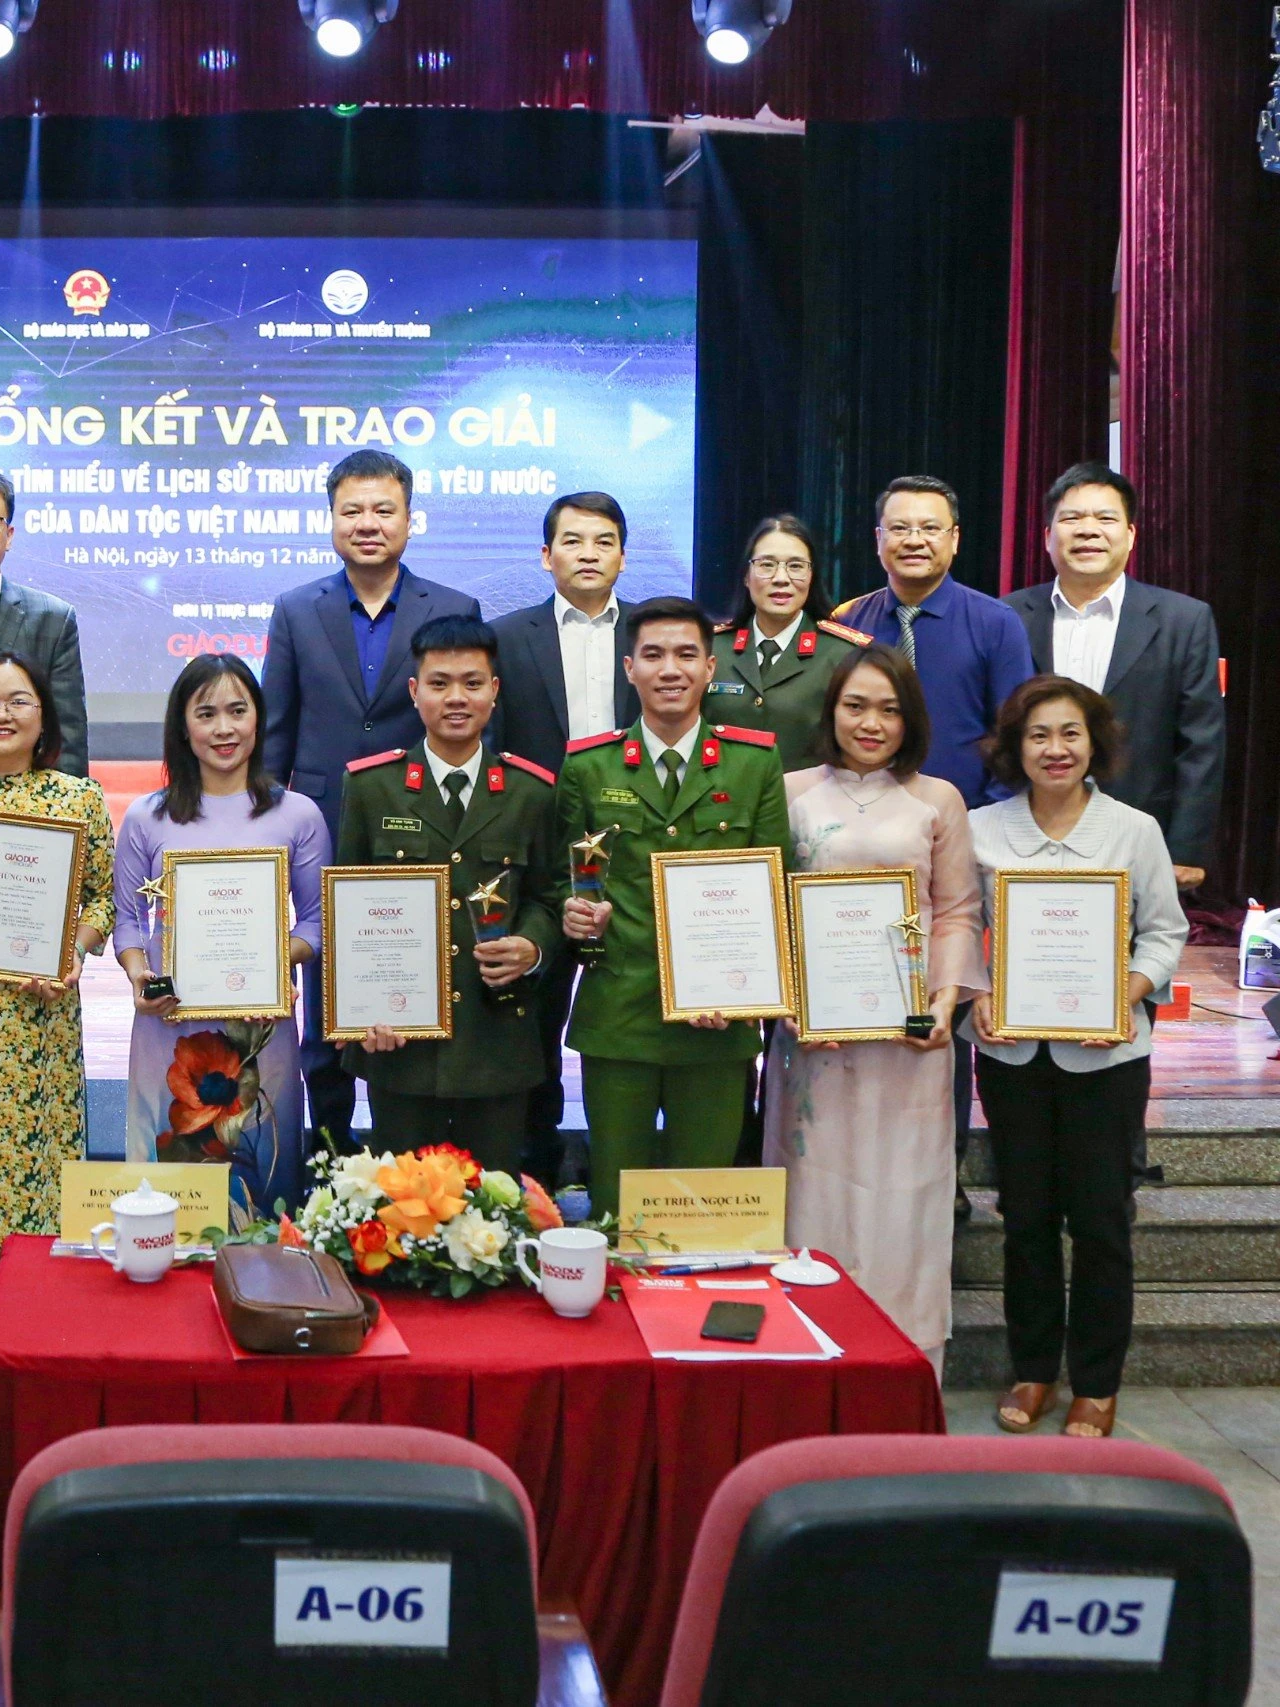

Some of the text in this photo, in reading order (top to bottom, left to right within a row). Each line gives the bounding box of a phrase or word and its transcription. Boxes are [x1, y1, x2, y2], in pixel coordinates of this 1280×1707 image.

[121, 388, 203, 446] KẾT
[217, 394, 289, 447] VÀ
[299, 406, 436, 447] TRAO
[448, 392, 556, 447] GIẢI
[10, 464, 54, 493] TÌM
[60, 459, 115, 493] HIỂU
[121, 461, 151, 493] VỀ
[157, 468, 210, 498] LỊCH
[216, 460, 253, 493] SỬ
[255, 461, 328, 493] TRUYỀ
[438, 465, 484, 494] YÊU
[490, 466, 557, 494] NƯỚC
[24, 502, 72, 534] CỦA
[79, 505, 129, 533] DÂN
[135, 504, 180, 538] TỘC
[186, 504, 238, 538] VIỆT
[243, 509, 300, 534] NAM
[64, 547, 337, 568] Hà Nội, ngày 13 tháng 12 năm
[735, 1194, 761, 1205] LÂM
[296, 1585, 424, 1622] A-06
[1015, 1599, 1144, 1636] A-05
